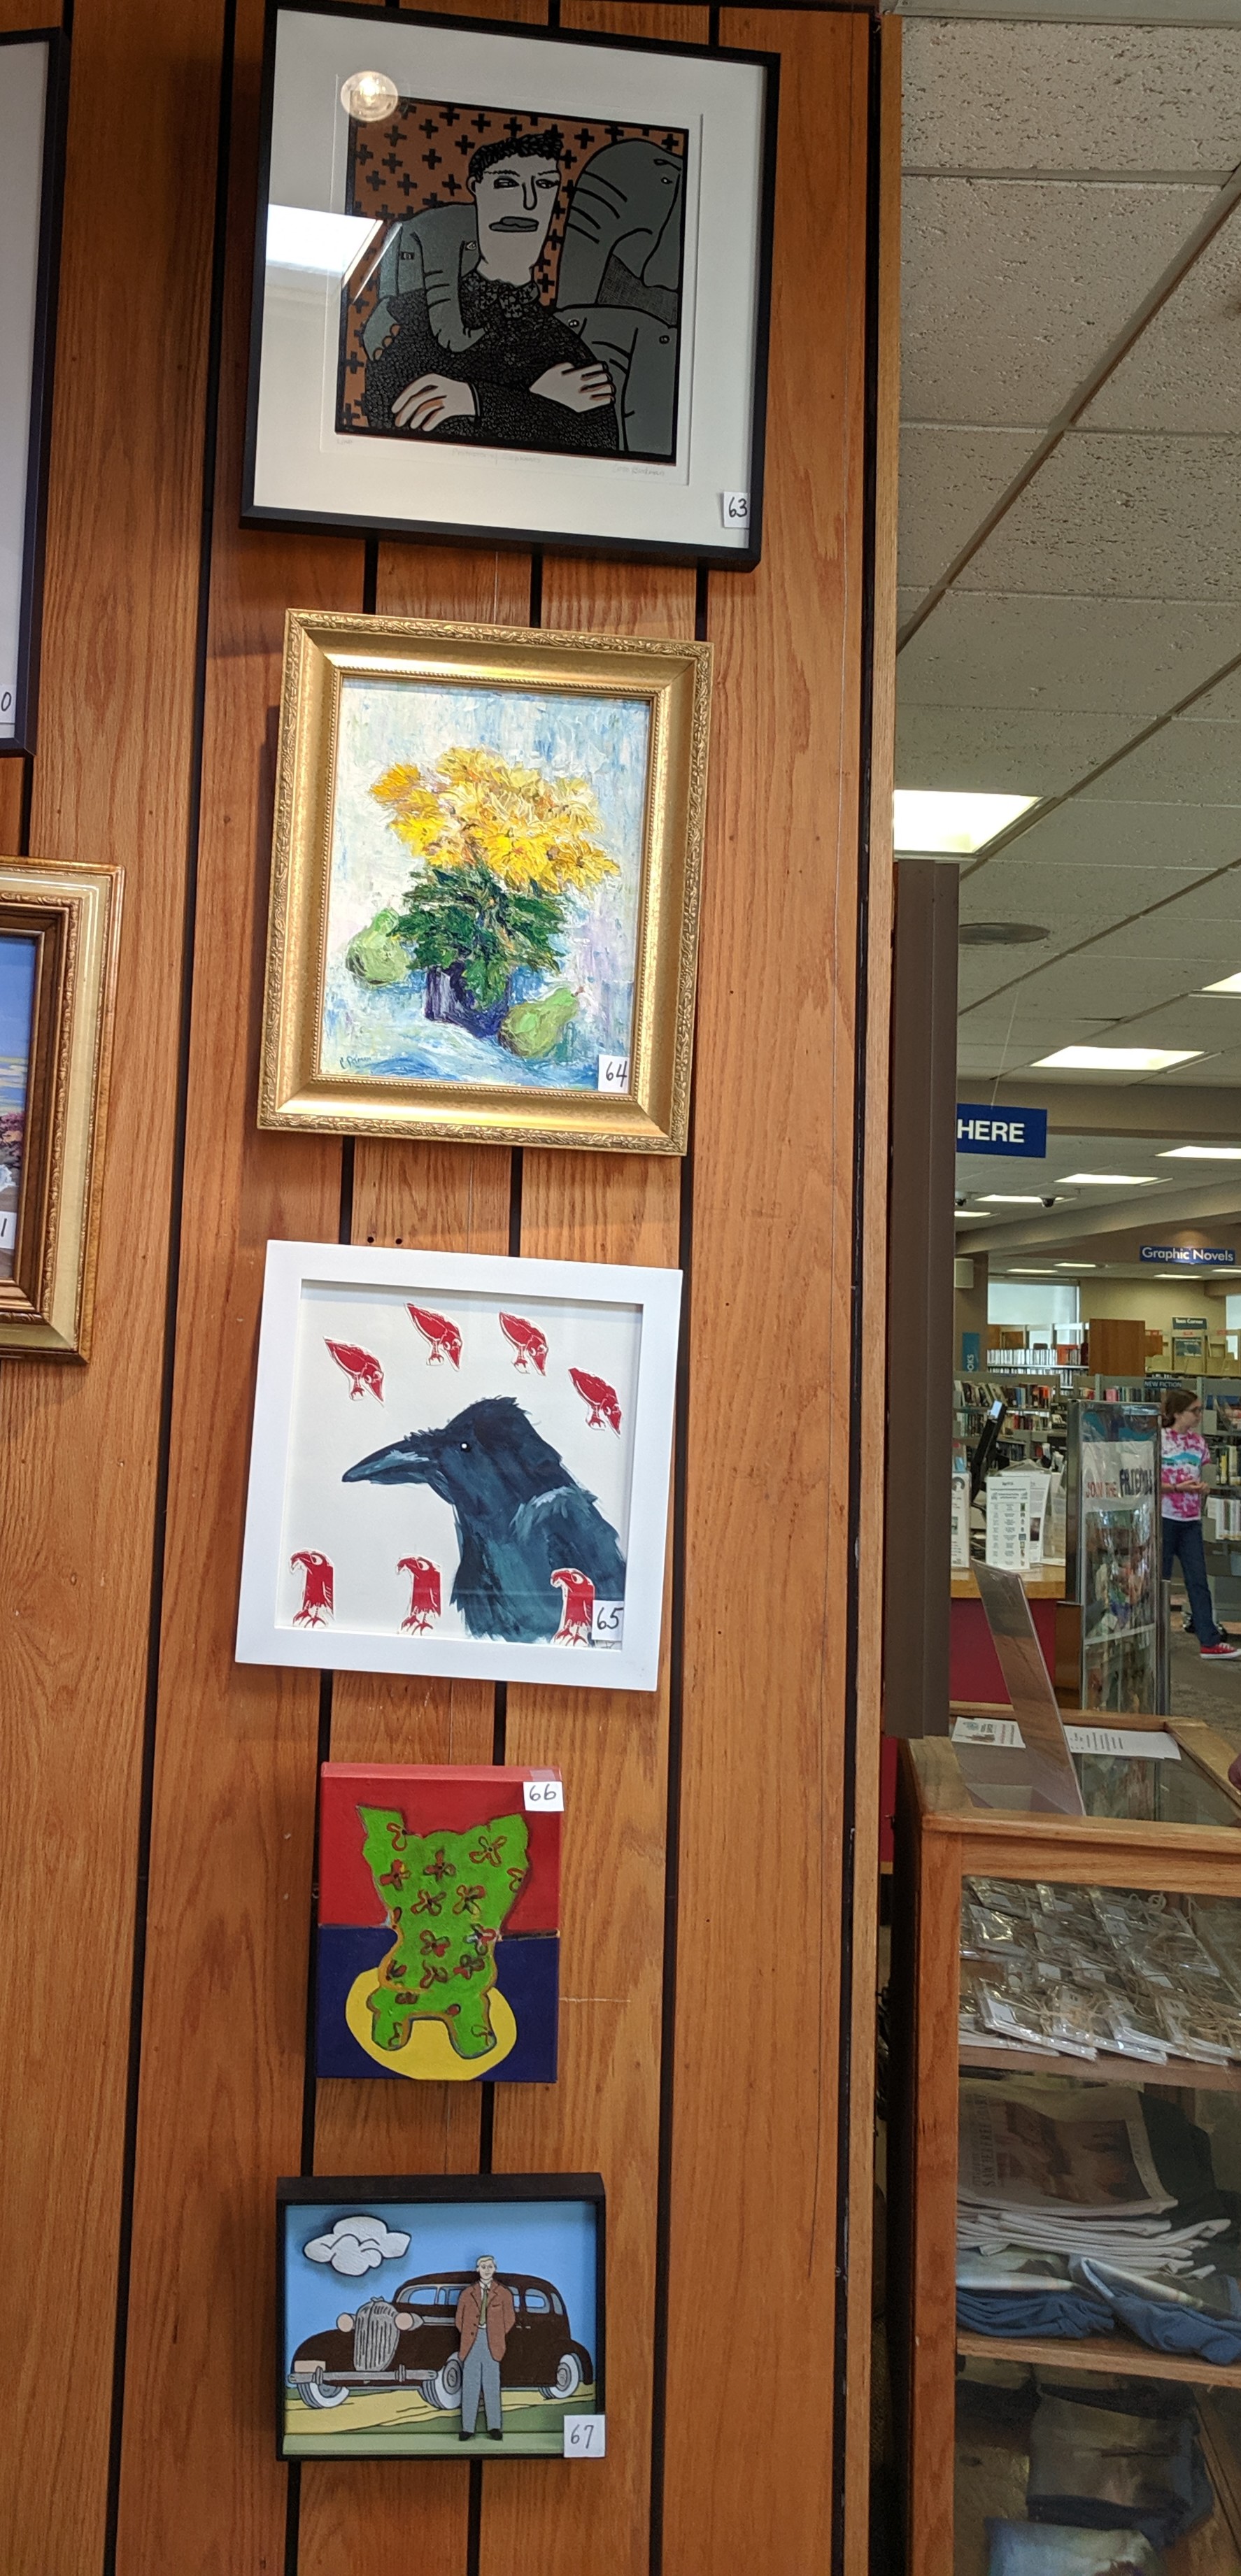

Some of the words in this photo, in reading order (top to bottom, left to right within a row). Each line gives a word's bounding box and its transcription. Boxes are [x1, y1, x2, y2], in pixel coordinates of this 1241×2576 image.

[728, 497, 748, 518] 63
[606, 1060, 627, 1088] 64
[956, 1118, 1026, 1144] HERE
[1142, 1246, 1189, 1261] Graphic
[1193, 1248, 1234, 1261] Novels
[597, 1607, 624, 1630] 65
[530, 1784, 557, 1802] 66
[570, 2424, 594, 2449] 67
